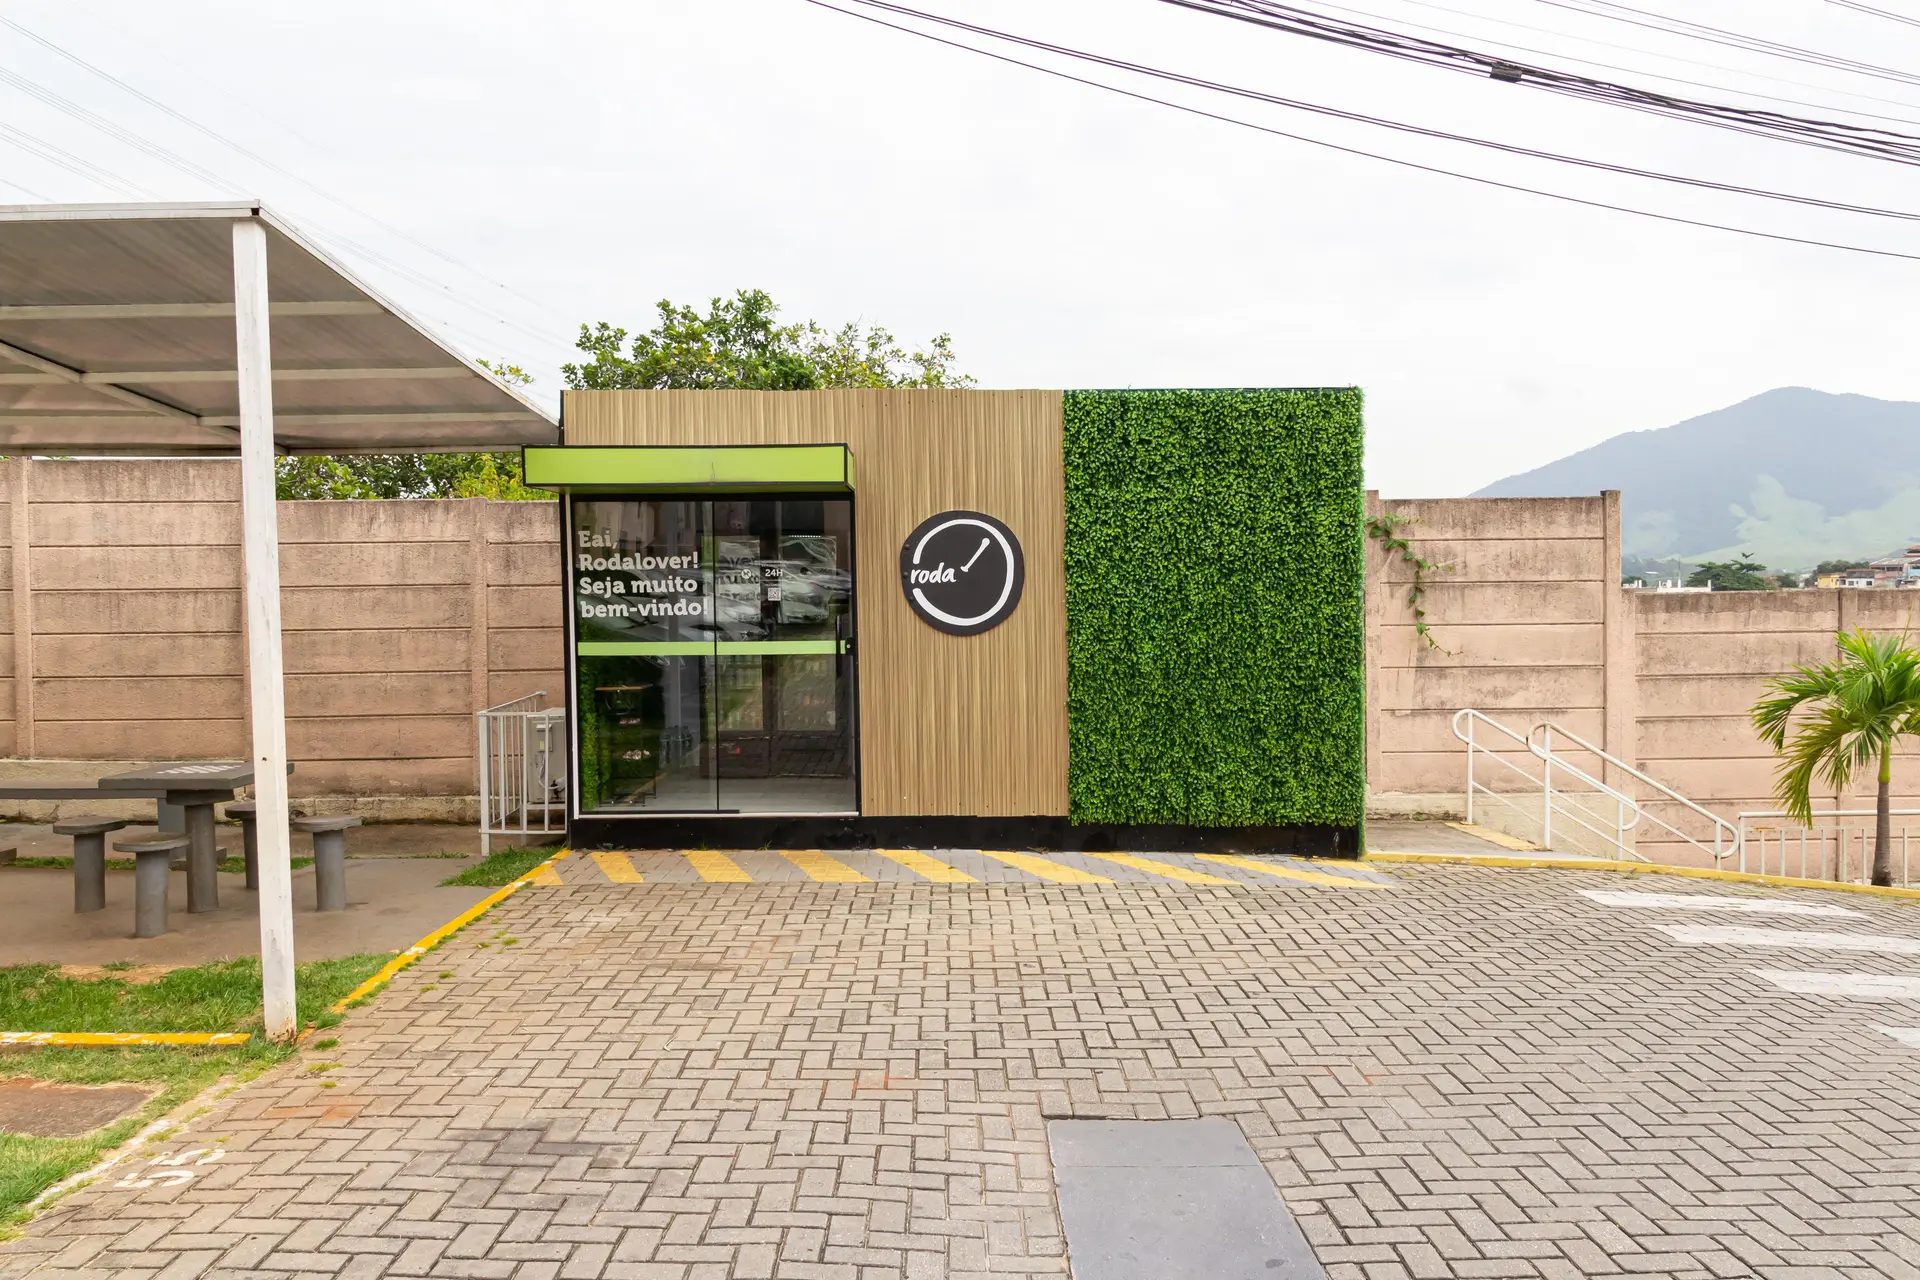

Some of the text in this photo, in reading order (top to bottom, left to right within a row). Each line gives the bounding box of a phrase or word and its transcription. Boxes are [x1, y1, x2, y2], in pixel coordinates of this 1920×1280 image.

[578, 530, 619, 549] Eai,
[578, 551, 699, 571] Rodalover!
[764, 568, 783, 577] 24H
[910, 562, 957, 584] roda
[579, 576, 626, 599] Seja
[631, 575, 698, 593] muito
[580, 598, 708, 618] bem-vindo!
